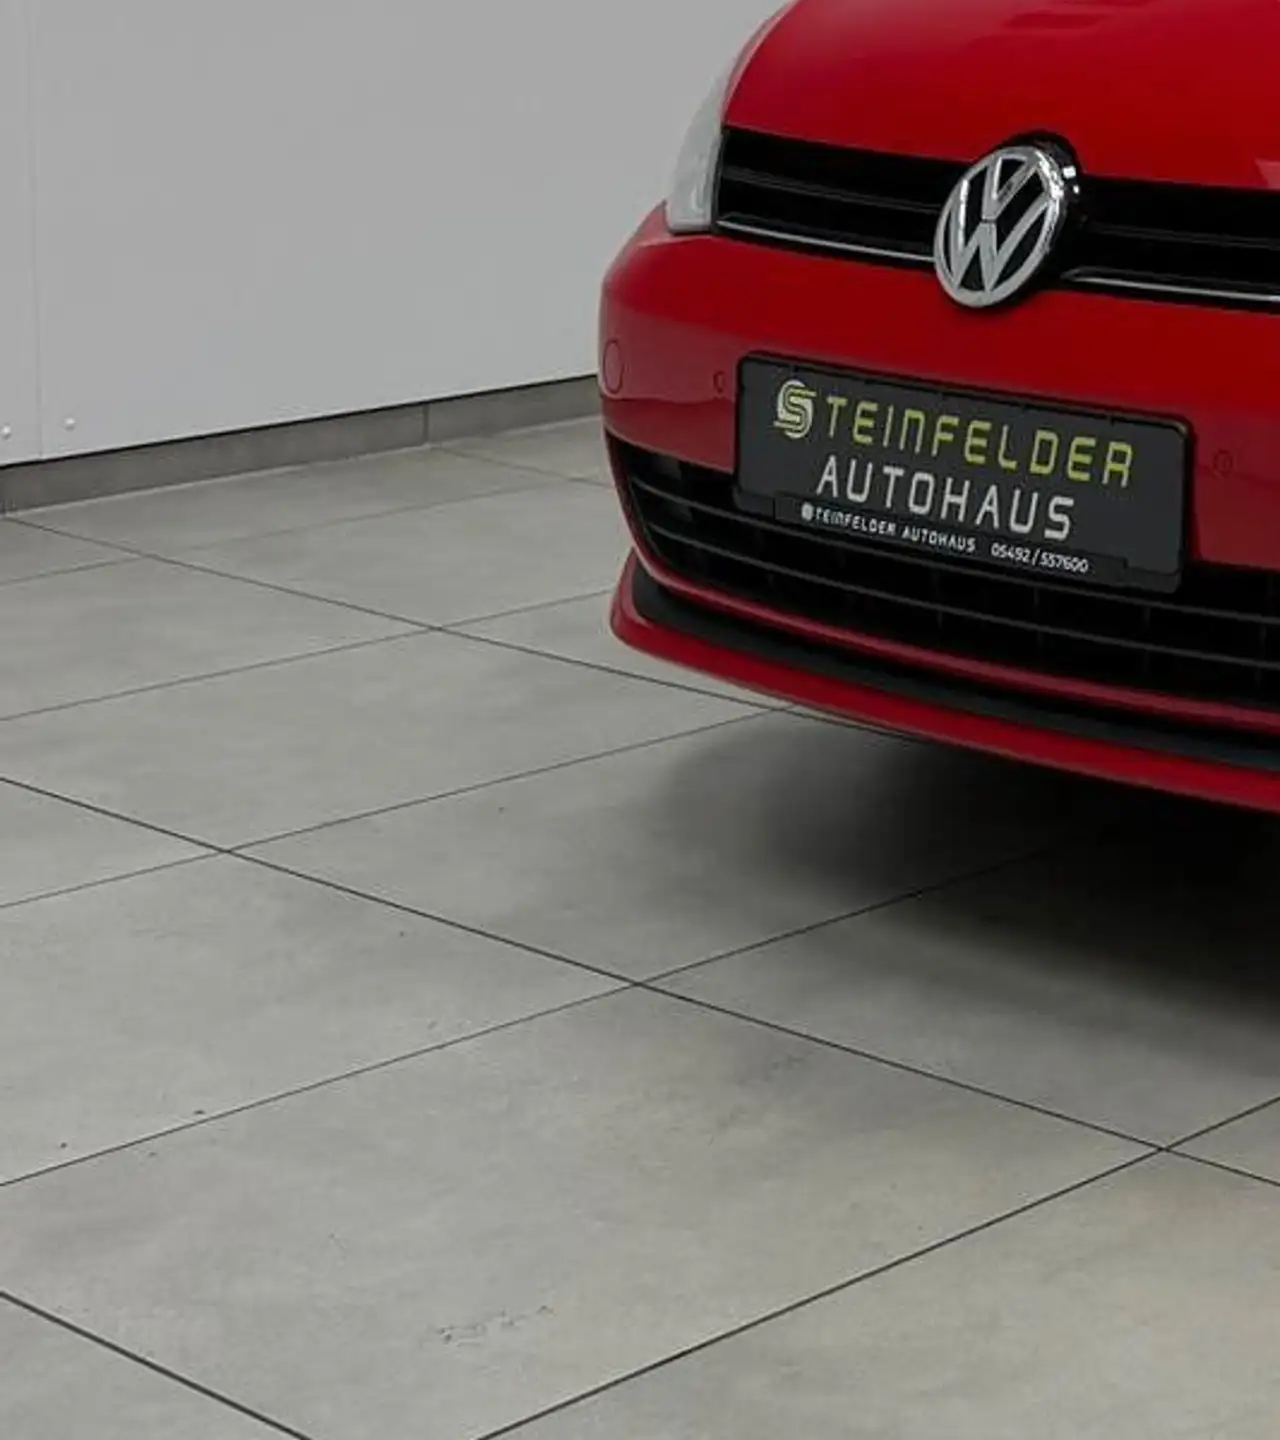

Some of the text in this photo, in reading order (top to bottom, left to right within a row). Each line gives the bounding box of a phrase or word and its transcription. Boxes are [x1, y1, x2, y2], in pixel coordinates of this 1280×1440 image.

[774, 380, 1134, 487] STEINFELDER
[816, 455, 1075, 541] AUTOHAUS
[902, 527, 977, 553] AUTOHAUS
